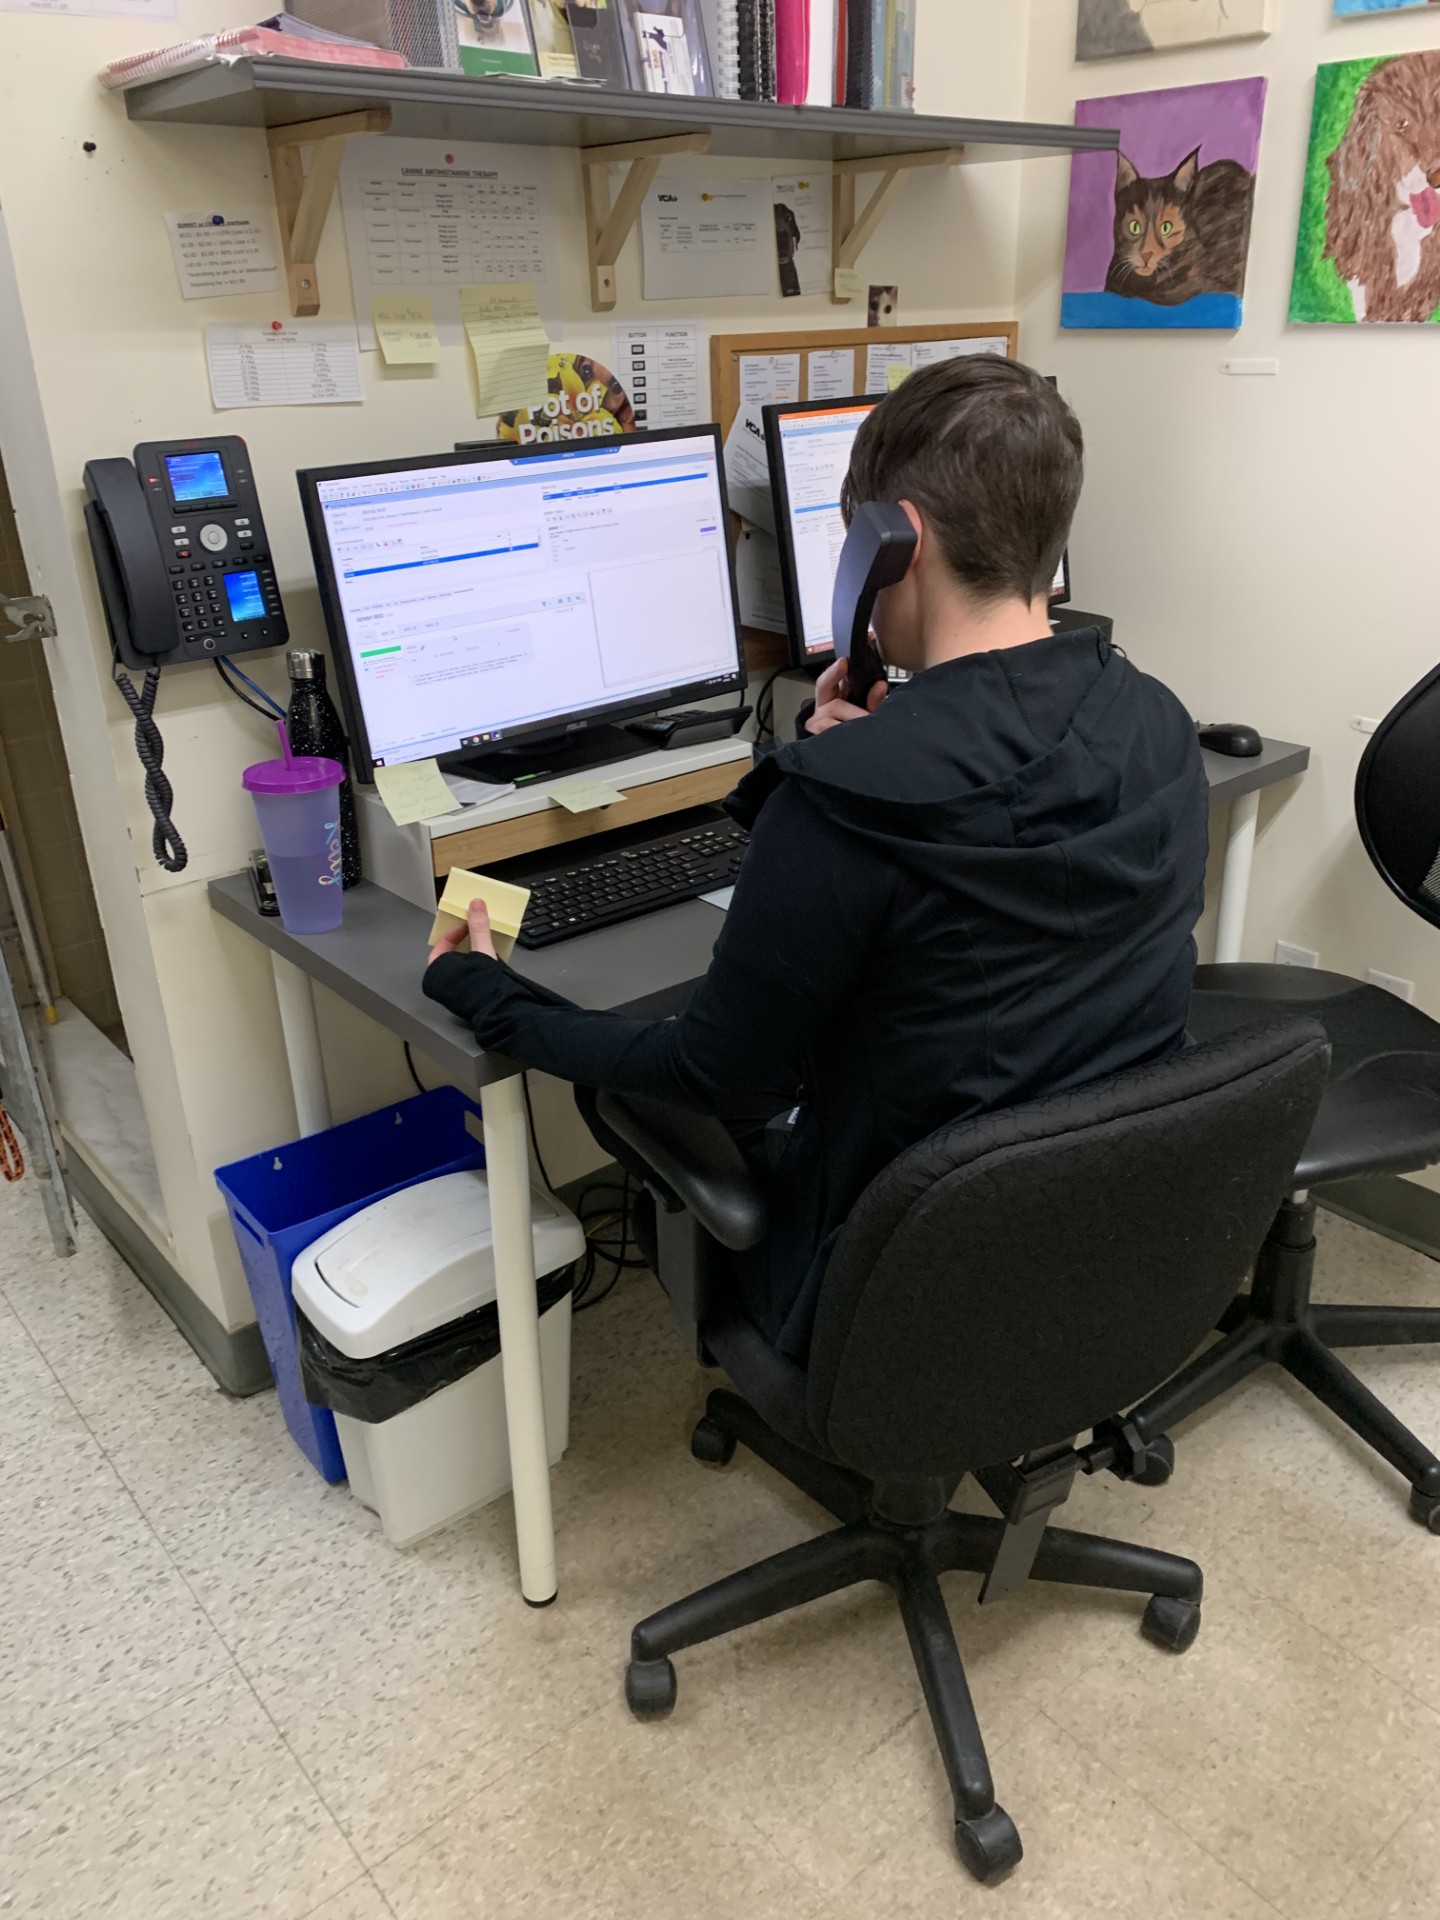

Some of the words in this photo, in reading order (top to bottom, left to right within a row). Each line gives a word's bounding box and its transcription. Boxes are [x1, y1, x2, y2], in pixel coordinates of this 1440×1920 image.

[658, 194, 673, 202] VCA
[576, 383, 601, 413] of
[518, 418, 615, 446] Poisons
[746, 418, 760, 438] VCA
